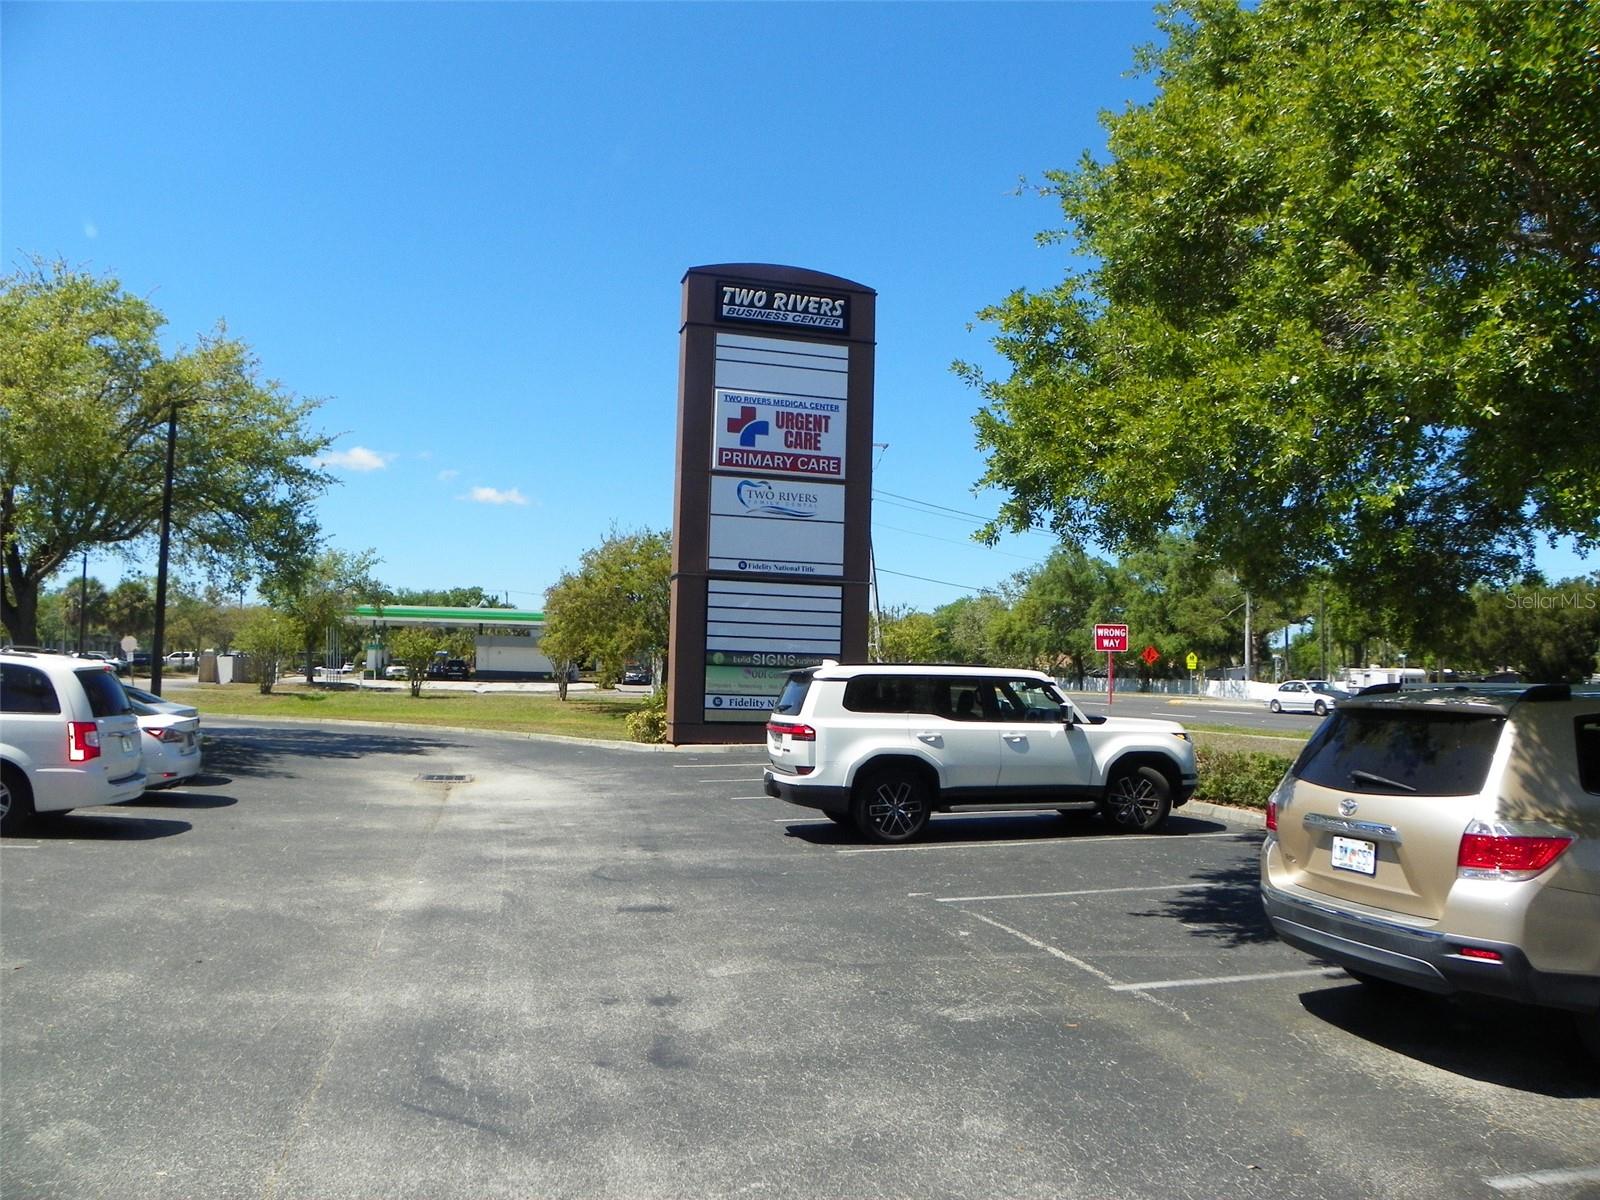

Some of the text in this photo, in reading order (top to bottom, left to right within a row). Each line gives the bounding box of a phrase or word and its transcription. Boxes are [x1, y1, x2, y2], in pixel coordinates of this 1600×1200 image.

[722, 286, 845, 316] TWO RIVERS
[726, 307, 840, 327] BUSINESS CENTER
[724, 394, 840, 412] TWO RIVERS MEDICAL CENTER
[775, 410, 831, 433] URGENT
[784, 430, 821, 451] CARE
[722, 451, 839, 472] PRIMARY CARE
[747, 489, 818, 504] TWO RIVERS
[748, 561, 815, 573] Fidelity National Title
[1097, 628, 1126, 637] WRONG
[1102, 639, 1120, 647] WAY
[752, 653, 796, 666] SIGNS
[729, 698, 764, 709] Fidelity
